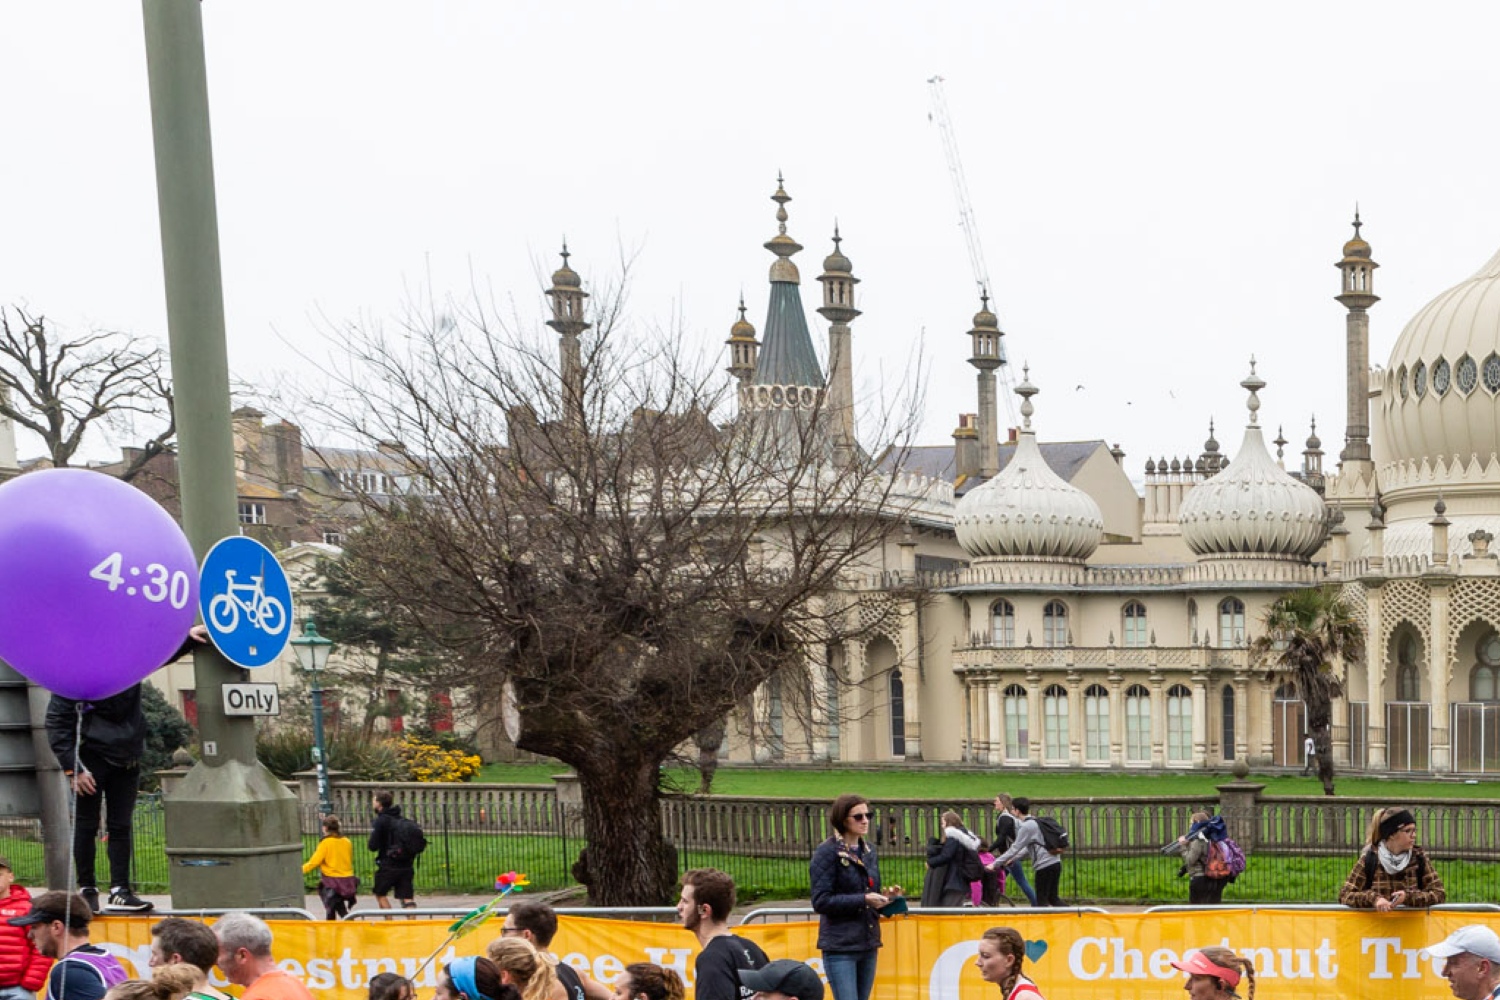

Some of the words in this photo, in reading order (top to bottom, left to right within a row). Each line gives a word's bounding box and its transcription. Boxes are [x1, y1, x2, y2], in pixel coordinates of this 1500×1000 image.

[89, 552, 189, 609] 4:30
[228, 689, 273, 712] Only
[207, 743, 214, 754] 1
[209, 946, 456, 991] estnu
[551, 951, 627, 985] ee
[1361, 937, 1452, 980] Tr
